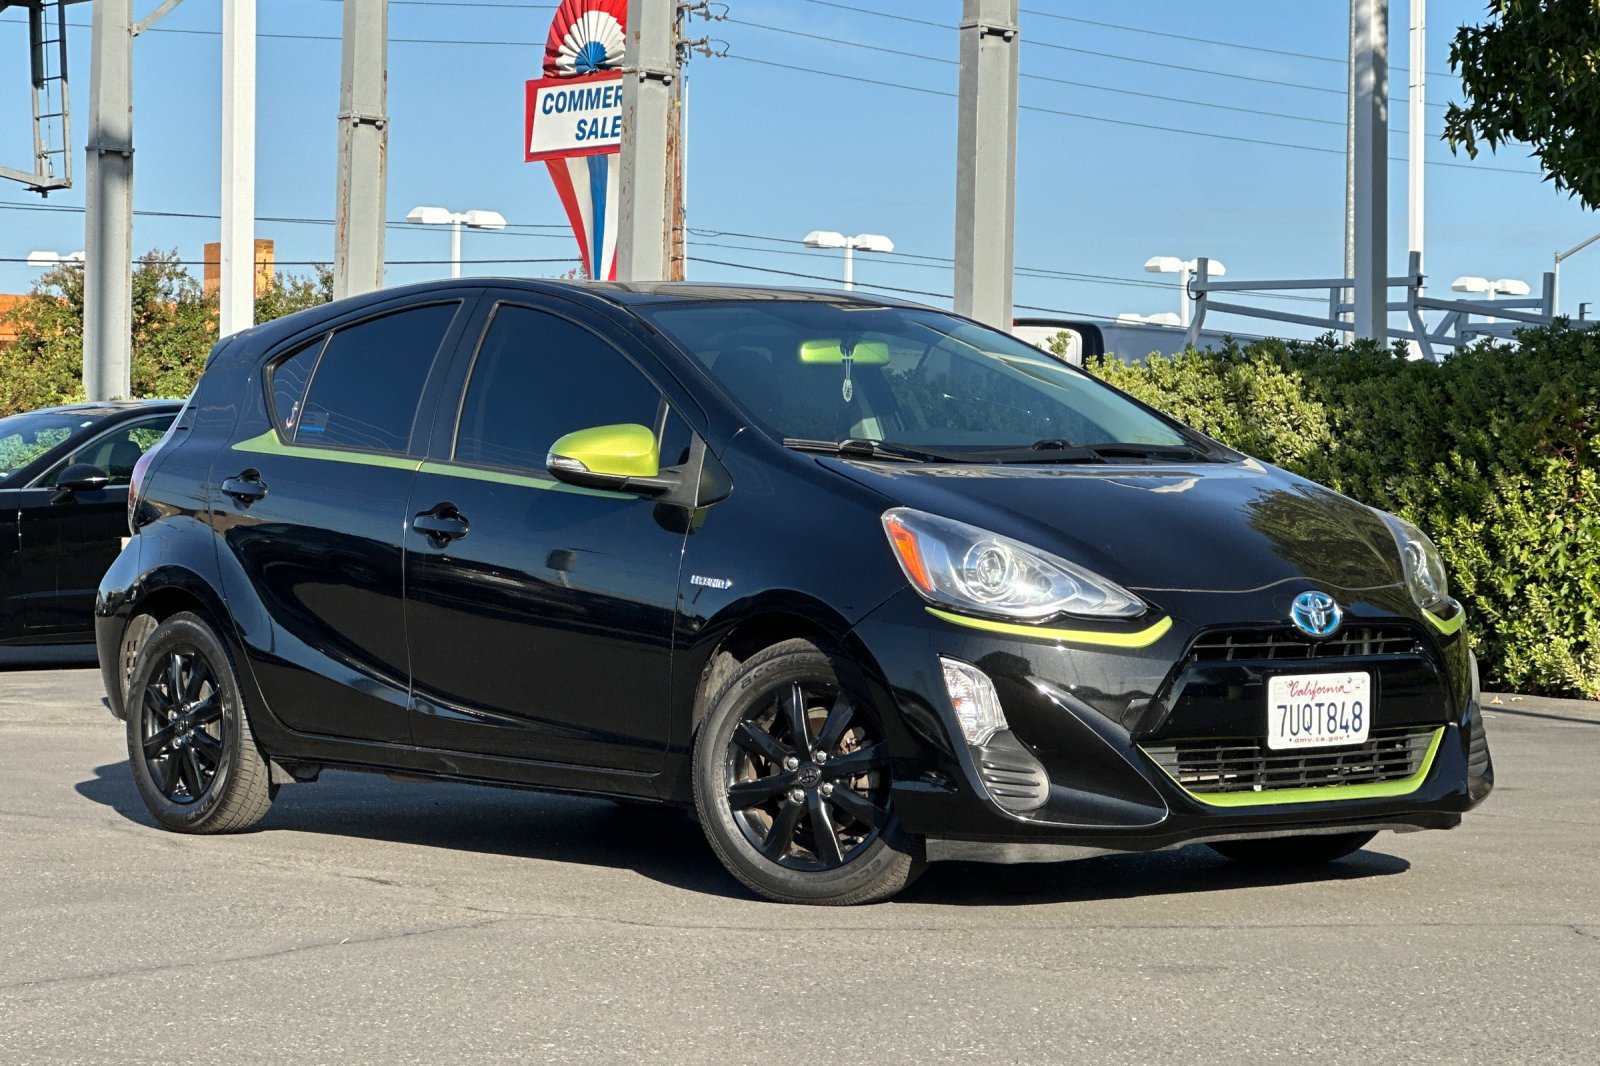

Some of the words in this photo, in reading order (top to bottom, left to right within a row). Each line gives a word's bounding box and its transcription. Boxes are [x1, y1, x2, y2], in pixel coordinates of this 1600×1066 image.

[542, 85, 622, 115] COMMER
[575, 115, 622, 141] SALE
[1289, 680, 1351, 701] California
[1277, 701, 1363, 737] 7UQT848
[1294, 736, 1345, 744] dmv.ca.gov
